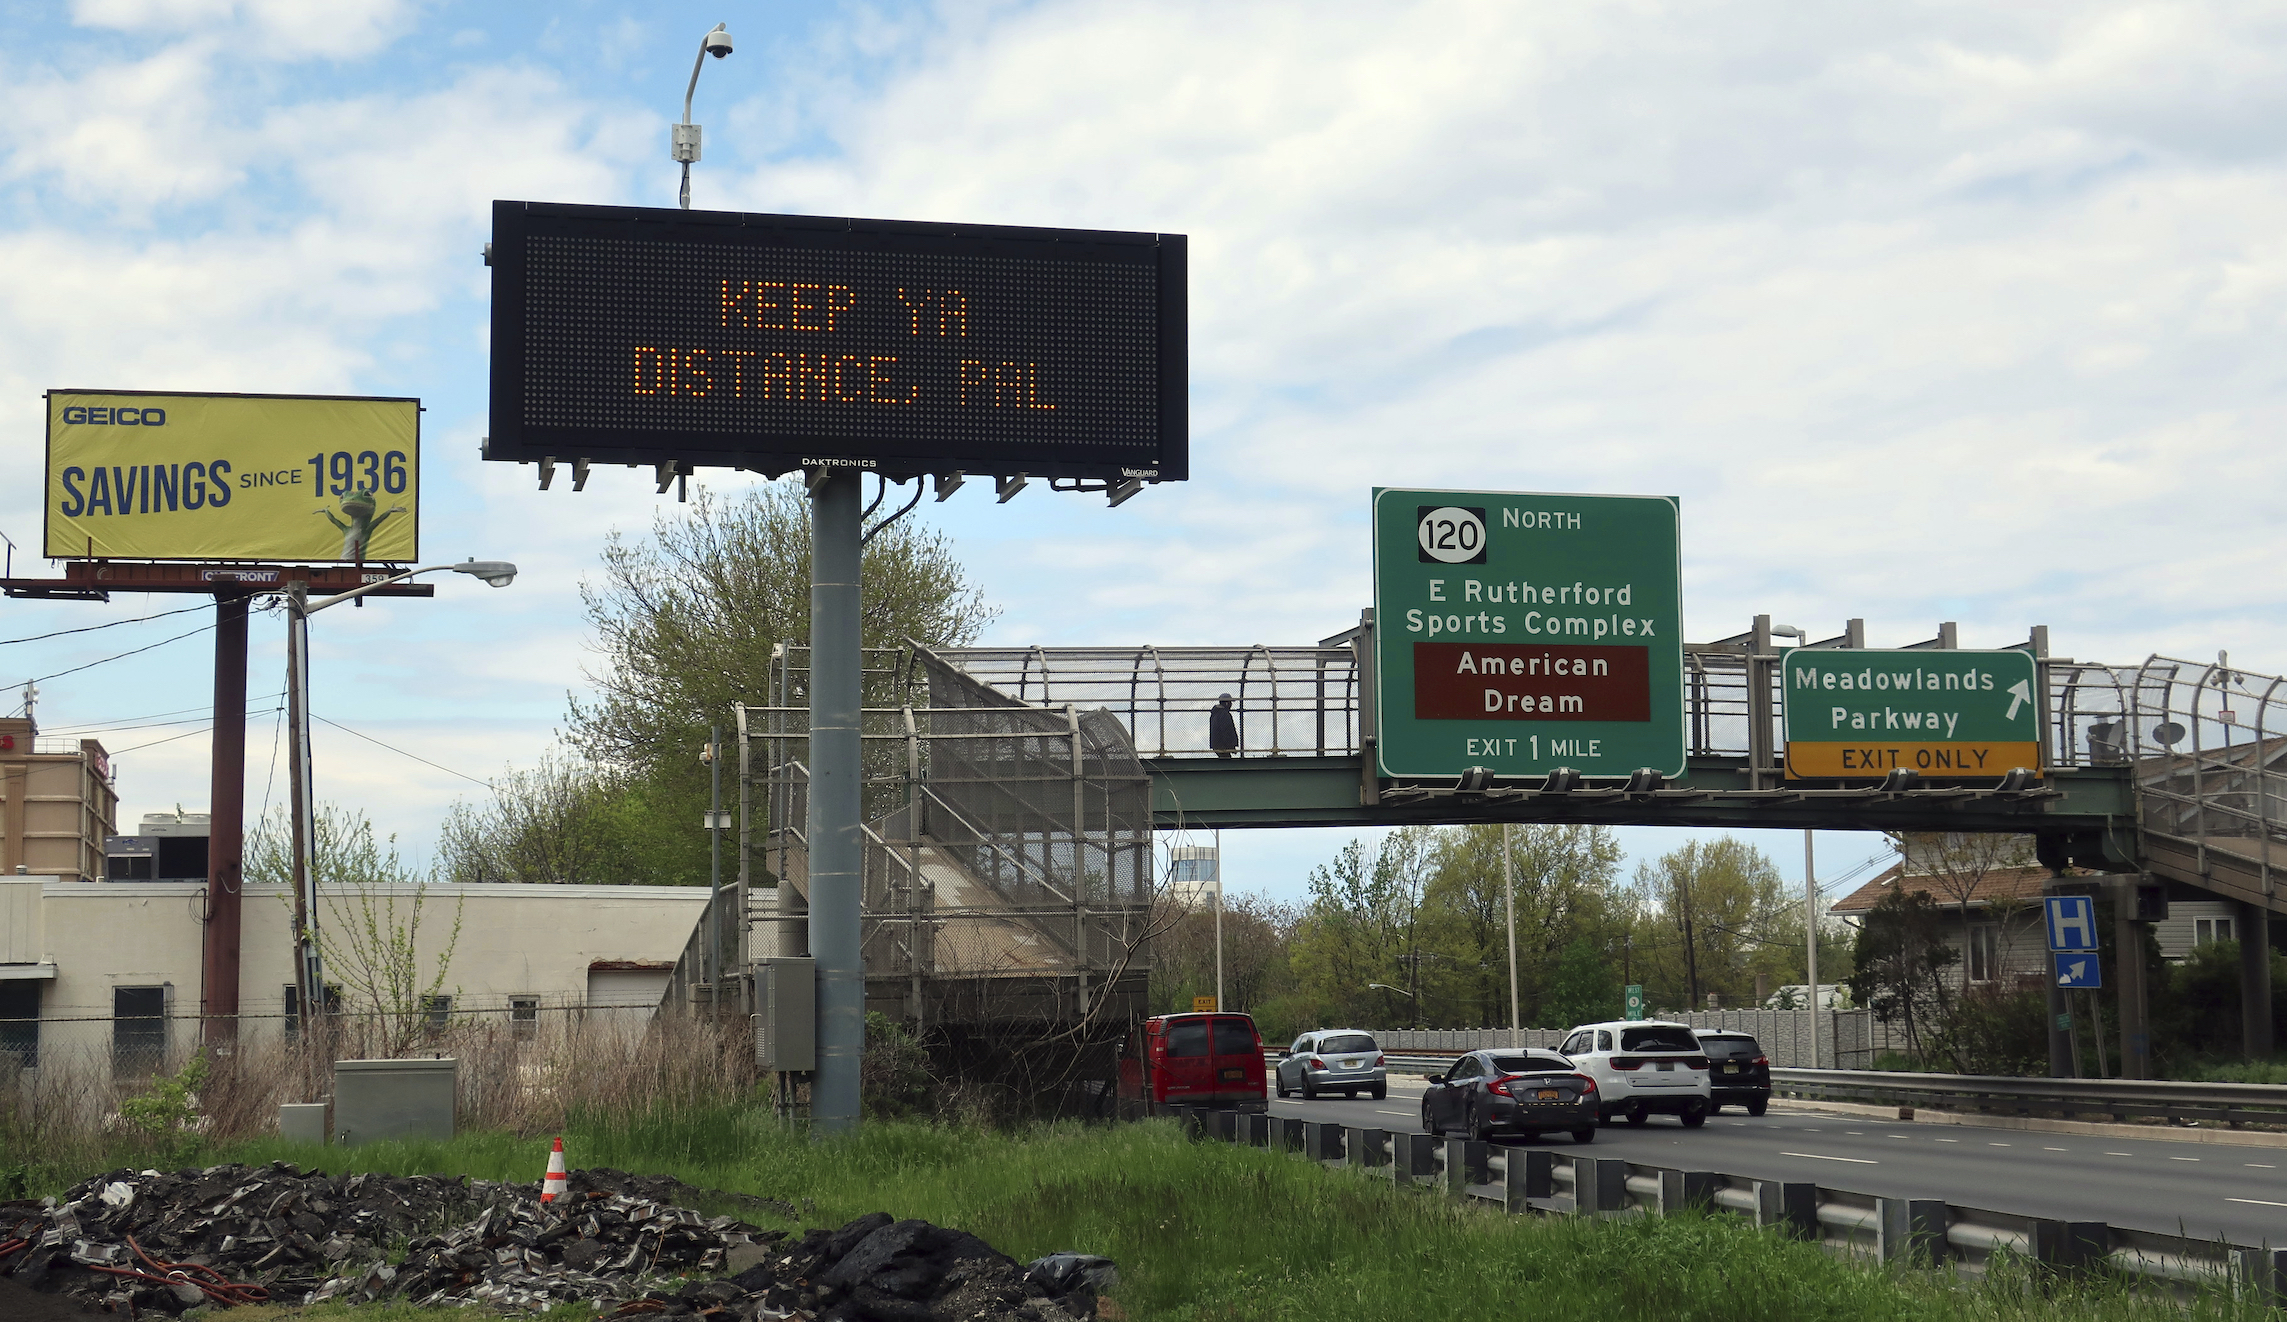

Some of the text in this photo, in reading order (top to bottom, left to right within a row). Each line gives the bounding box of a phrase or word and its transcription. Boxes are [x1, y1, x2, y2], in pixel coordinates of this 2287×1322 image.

[720, 279, 967, 338] KEEP YA
[633, 345, 1056, 410] DISTANCE, PAL
[63, 406, 166, 427] GEICO
[801, 457, 877, 468] DAKTRONICS
[1121, 466, 1159, 477] VANGUARD
[61, 450, 407, 518] SAVINGS SINCE 1936
[1425, 507, 1582, 551] 120 NORTH
[1429, 579, 1632, 606] E Rutherford
[1405, 608, 1656, 640] Sports Complex
[1456, 651, 1609, 677] American
[1795, 667, 1995, 691] Meadowlands
[1484, 688, 1584, 713] Dream
[1831, 706, 1959, 738] Parkway
[1466, 735, 1602, 760] EXIT 1 MILE
[1842, 749, 1989, 770] EXIT ONLY
[2051, 900, 2091, 947] H
